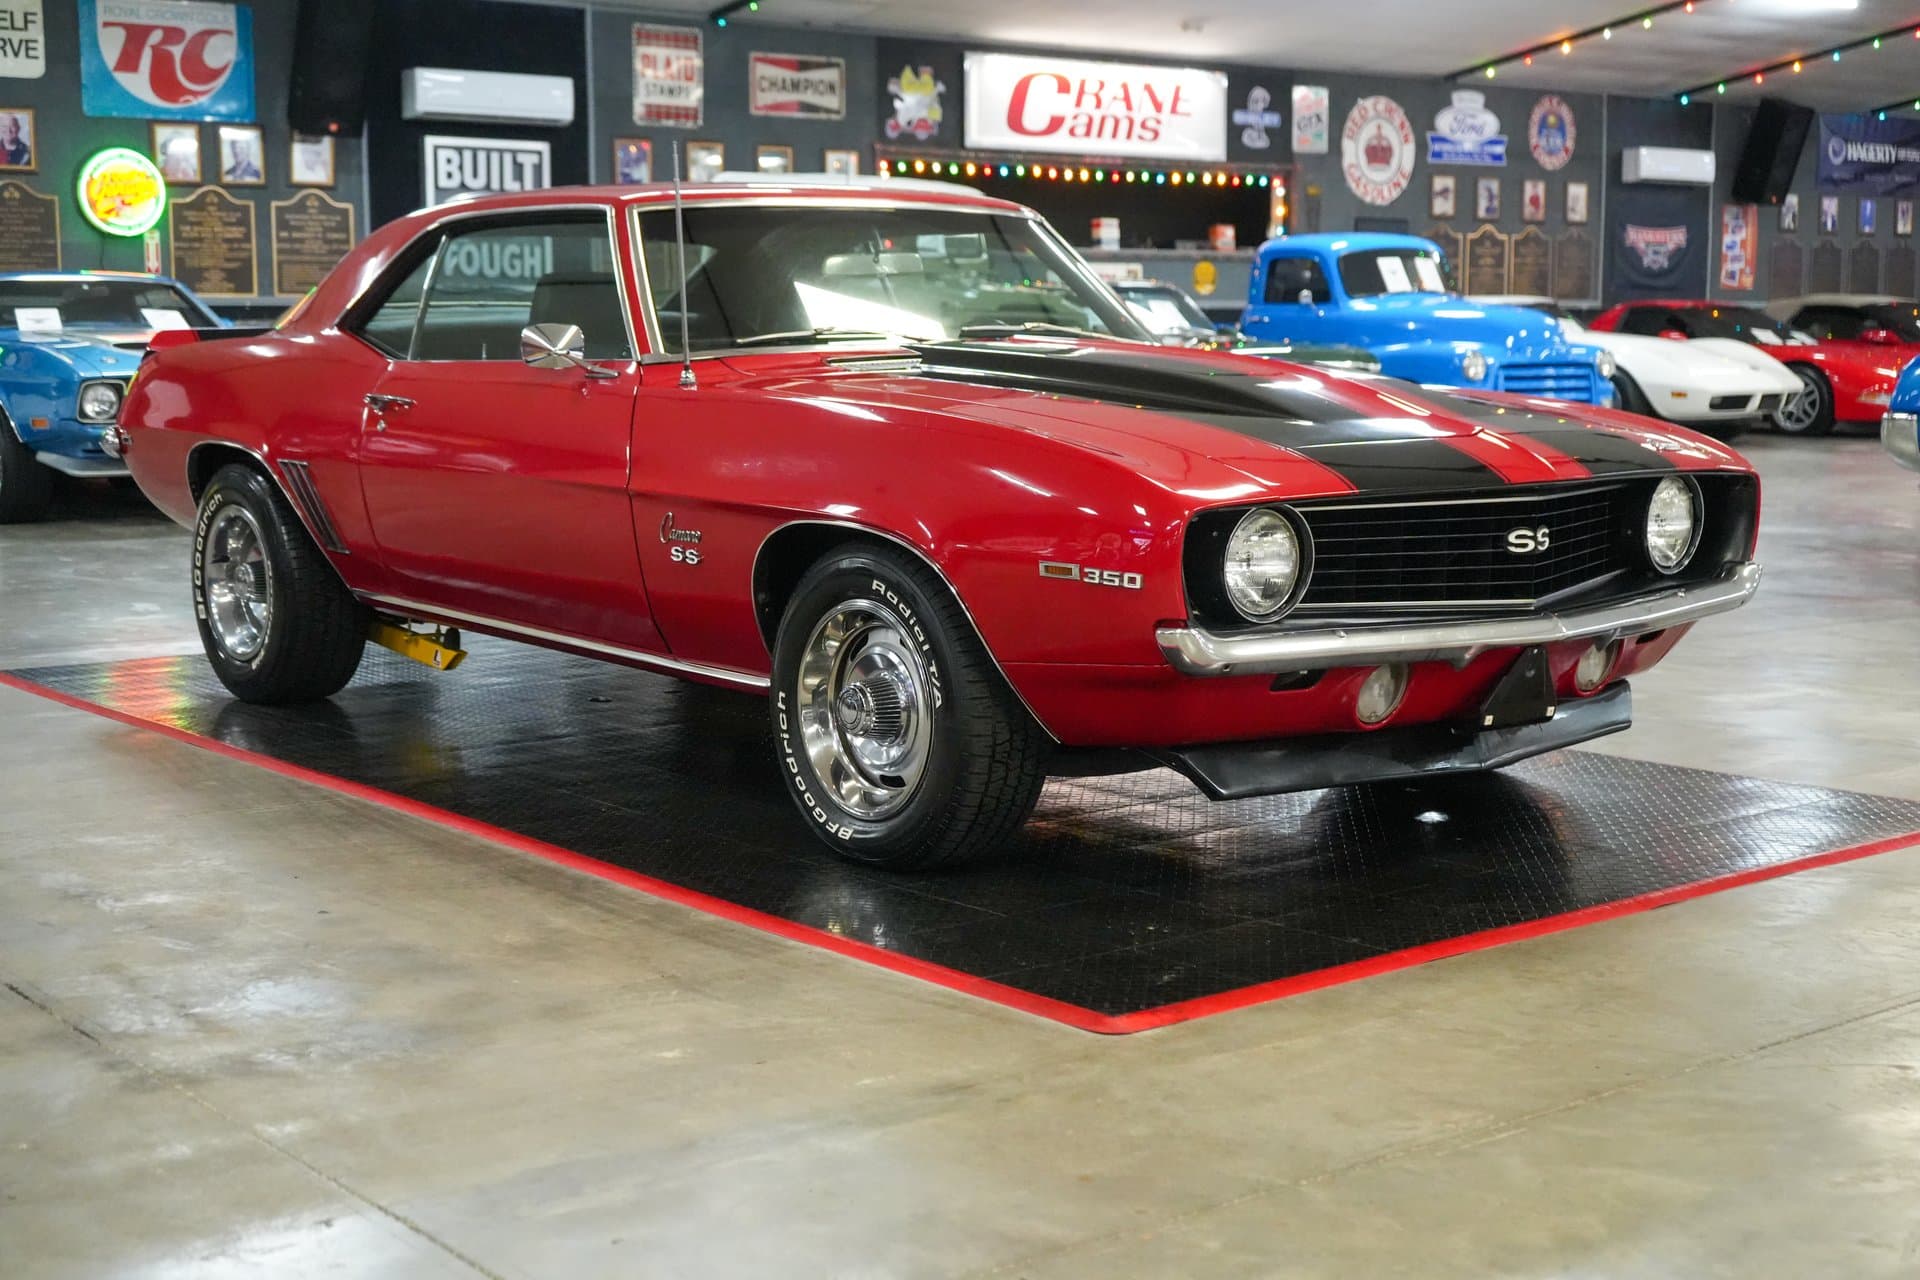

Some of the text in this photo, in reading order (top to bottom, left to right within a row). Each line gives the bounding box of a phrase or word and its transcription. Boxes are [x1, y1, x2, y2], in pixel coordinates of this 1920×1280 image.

[0, 10, 38, 31] ELF
[0, 37, 40, 59] RVE
[102, 21, 234, 104] RC
[758, 75, 837, 96] CHAMPION
[1847, 140, 1898, 164] HAGERTY
[436, 146, 541, 192] BUILT
[1506, 526, 1550, 553] SS
[670, 546, 699, 565] SS
[1083, 567, 1143, 589] 350
[871, 579, 943, 710] Radial T/A
[776, 690, 854, 841] BFGoodrich
